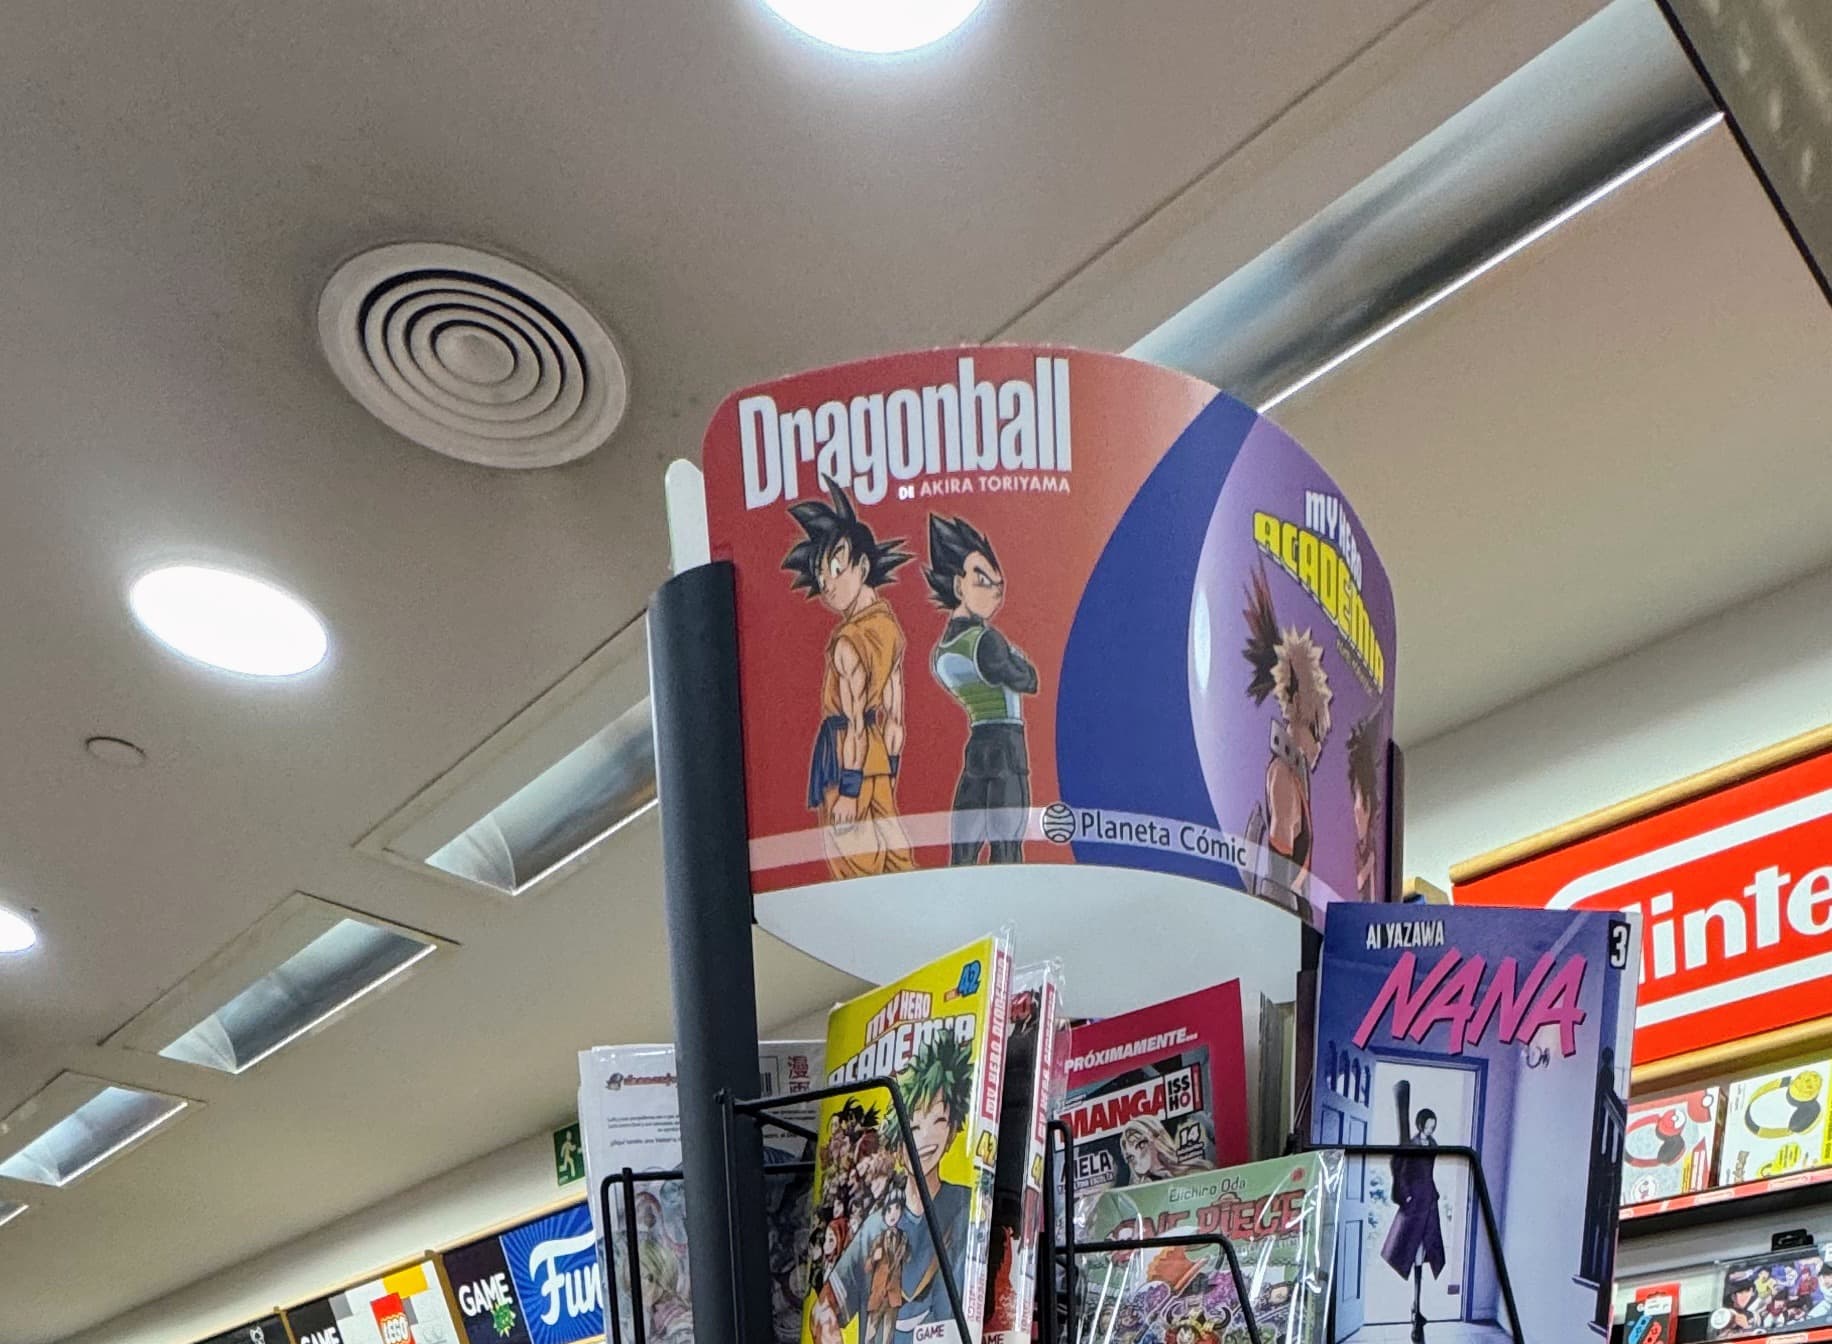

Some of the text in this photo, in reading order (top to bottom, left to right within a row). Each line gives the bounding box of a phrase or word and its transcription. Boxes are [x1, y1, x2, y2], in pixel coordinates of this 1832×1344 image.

[739, 357, 1071, 510] Dragonball
[920, 480, 974, 498] AKIRA
[977, 475, 1071, 495] TORIYAMA
[1304, 490, 1338, 541] MY
[1253, 511, 1385, 694] ACADEMIA
[1080, 812, 1248, 866] Planeta Cómic
[1366, 921, 1445, 949] AI YAZAWA
[1610, 926, 1628, 968] 3
[958, 960, 981, 997] 42
[866, 991, 932, 1044] MY HERO
[1353, 949, 1588, 1056] NANA
[1064, 1027, 1198, 1074] PRÓXIMAMENTE...
[1168, 1075, 1190, 1096] ISS
[1060, 1083, 1165, 1144] MANGA
[1220, 1176, 1246, 1193] Oda
[1197, 1189, 1307, 1242] PIECE
[459, 1272, 513, 1317] GAME
[916, 1324, 945, 1342] GAME
